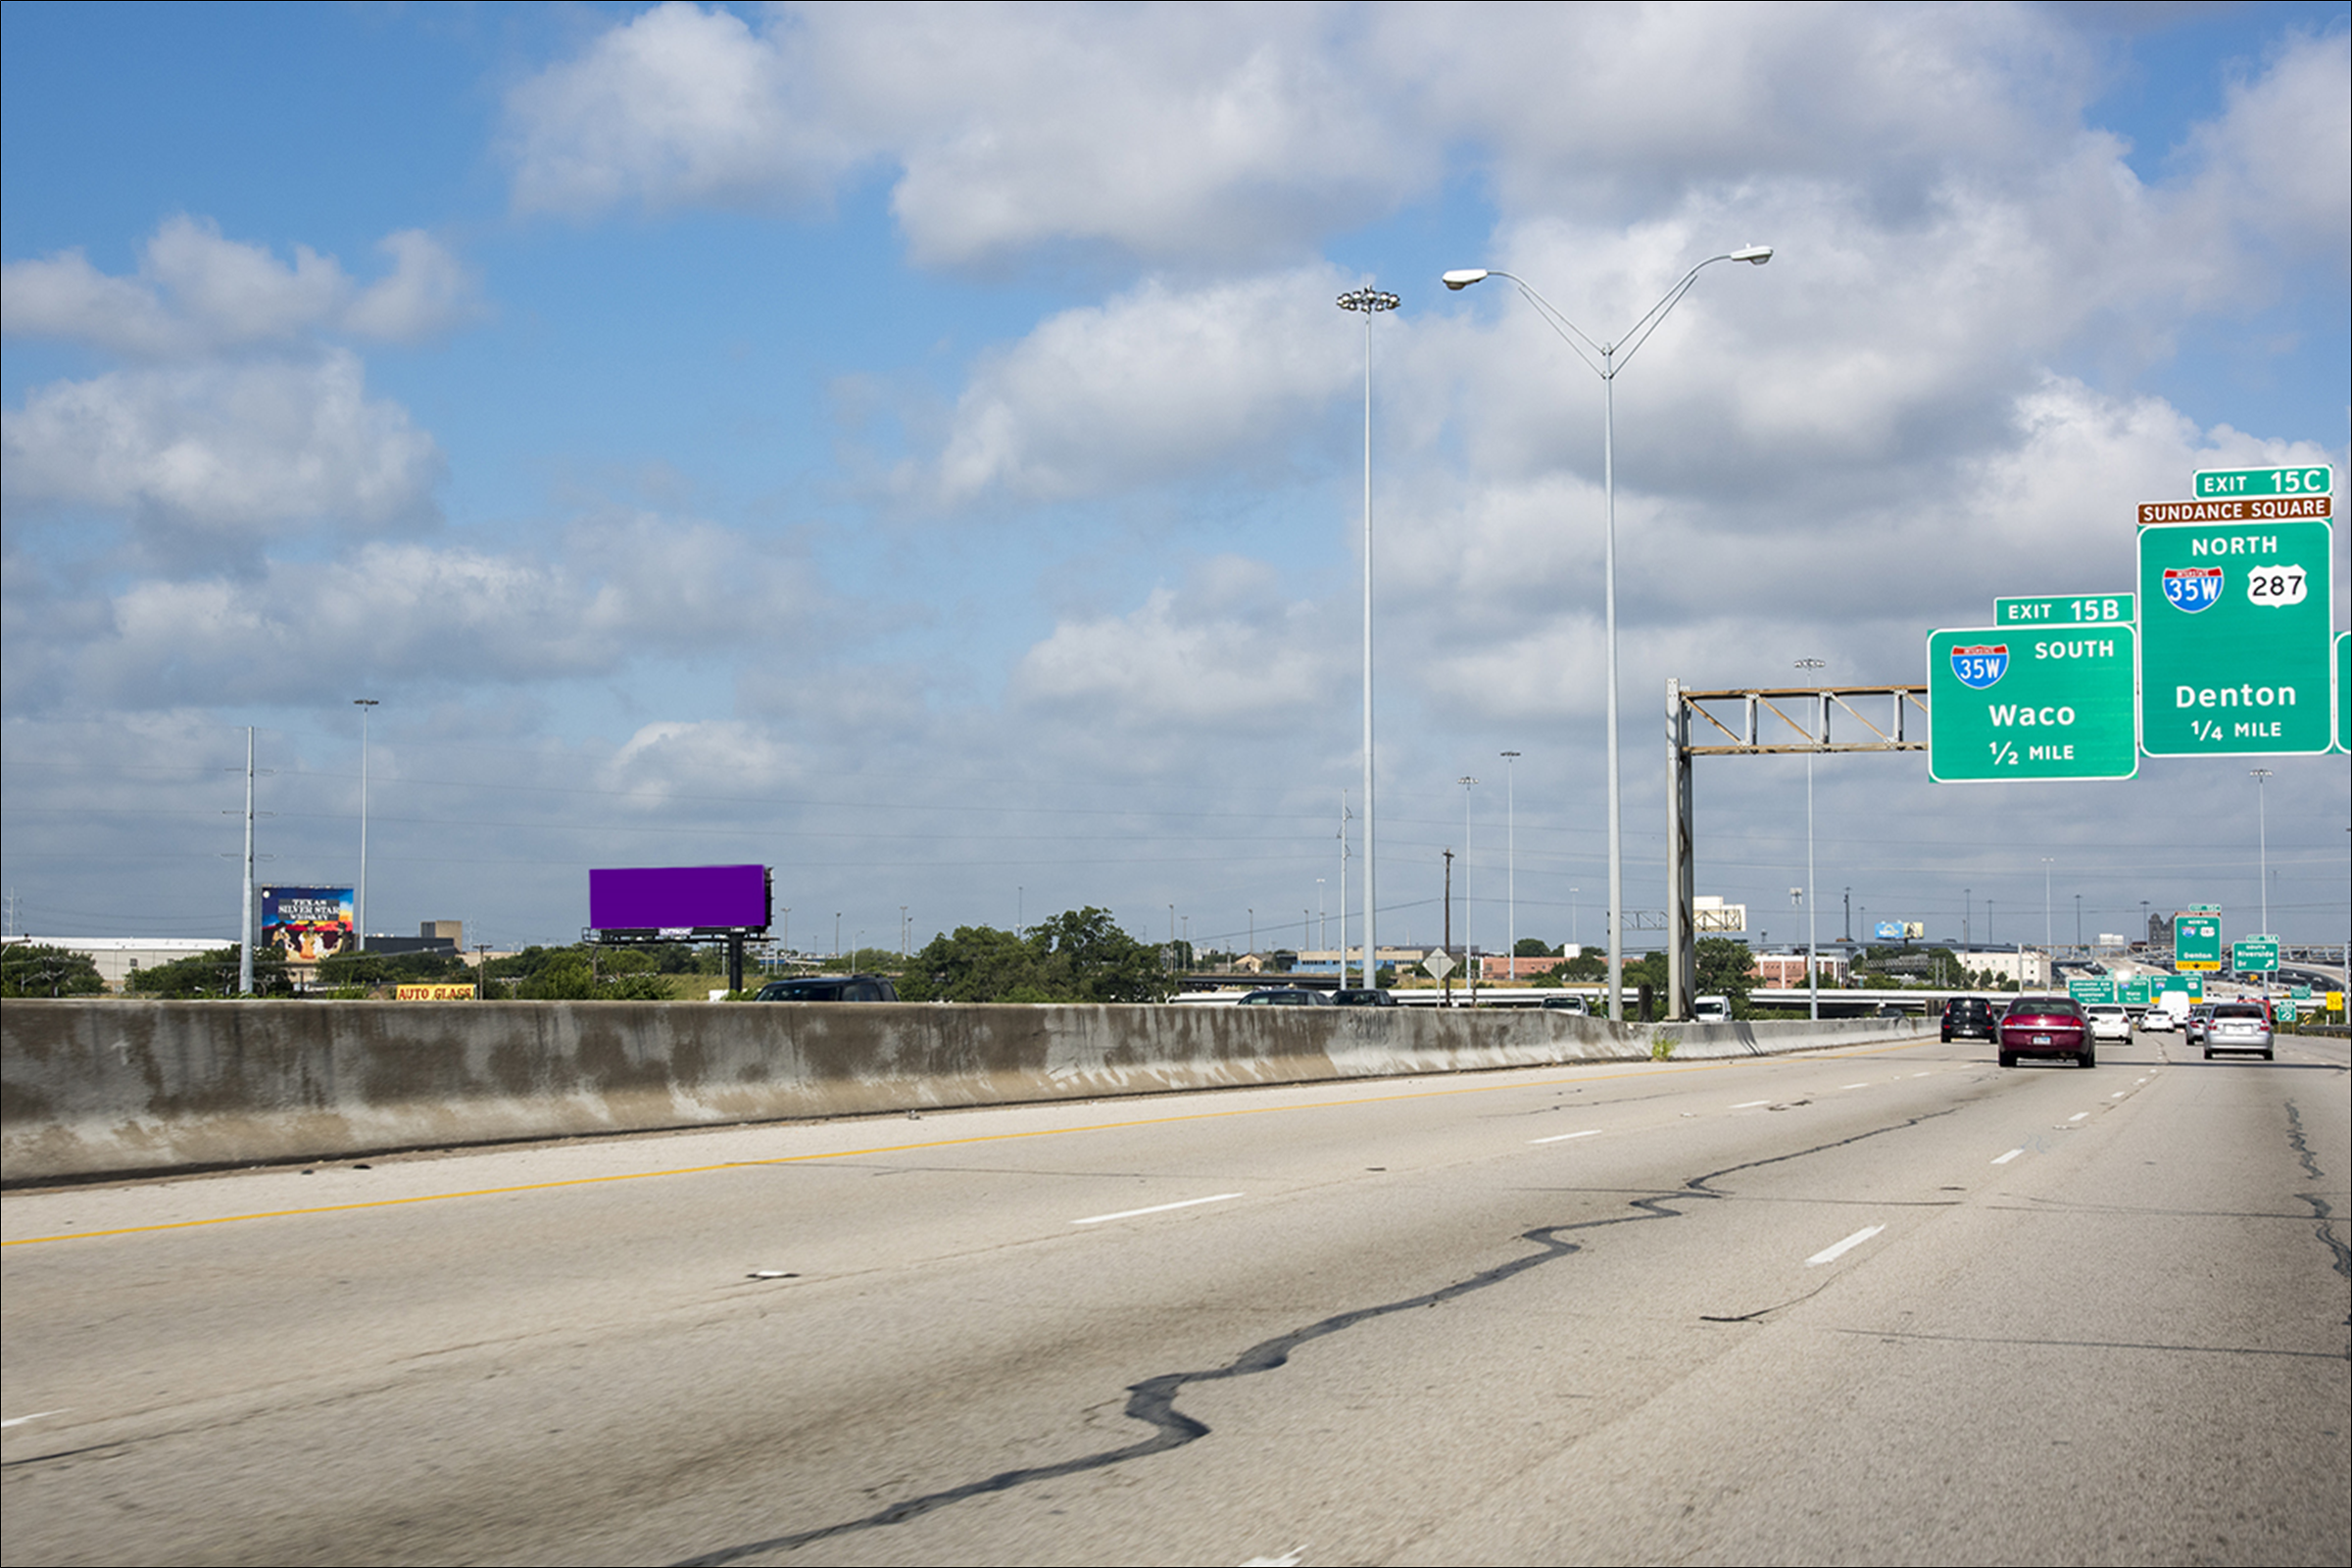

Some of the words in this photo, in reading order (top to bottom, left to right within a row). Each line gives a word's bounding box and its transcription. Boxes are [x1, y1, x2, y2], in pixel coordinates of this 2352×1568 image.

[2204, 475, 2247, 493] EXIT
[2271, 469, 2322, 493] 15C
[2143, 503, 2243, 521] SUNDANCE
[2251, 499, 2326, 518] SQUARE
[2191, 535, 2278, 556] NORTH
[2169, 578, 2218, 602] 35W
[2252, 575, 2303, 596] 287
[2008, 604, 2052, 619] EXIT
[2070, 599, 2120, 621] 15B
[2034, 640, 2114, 660] SOUTH
[1960, 659, 2000, 679] 35W
[2176, 683, 2296, 708] Denton
[1988, 704, 2076, 727] Waco
[2233, 721, 2281, 737] MILE
[2029, 745, 2075, 760] MILE
[278, 905, 313, 913] SILVER
[399, 988, 429, 1000] AUTO
[434, 987, 471, 1000] GLASS
